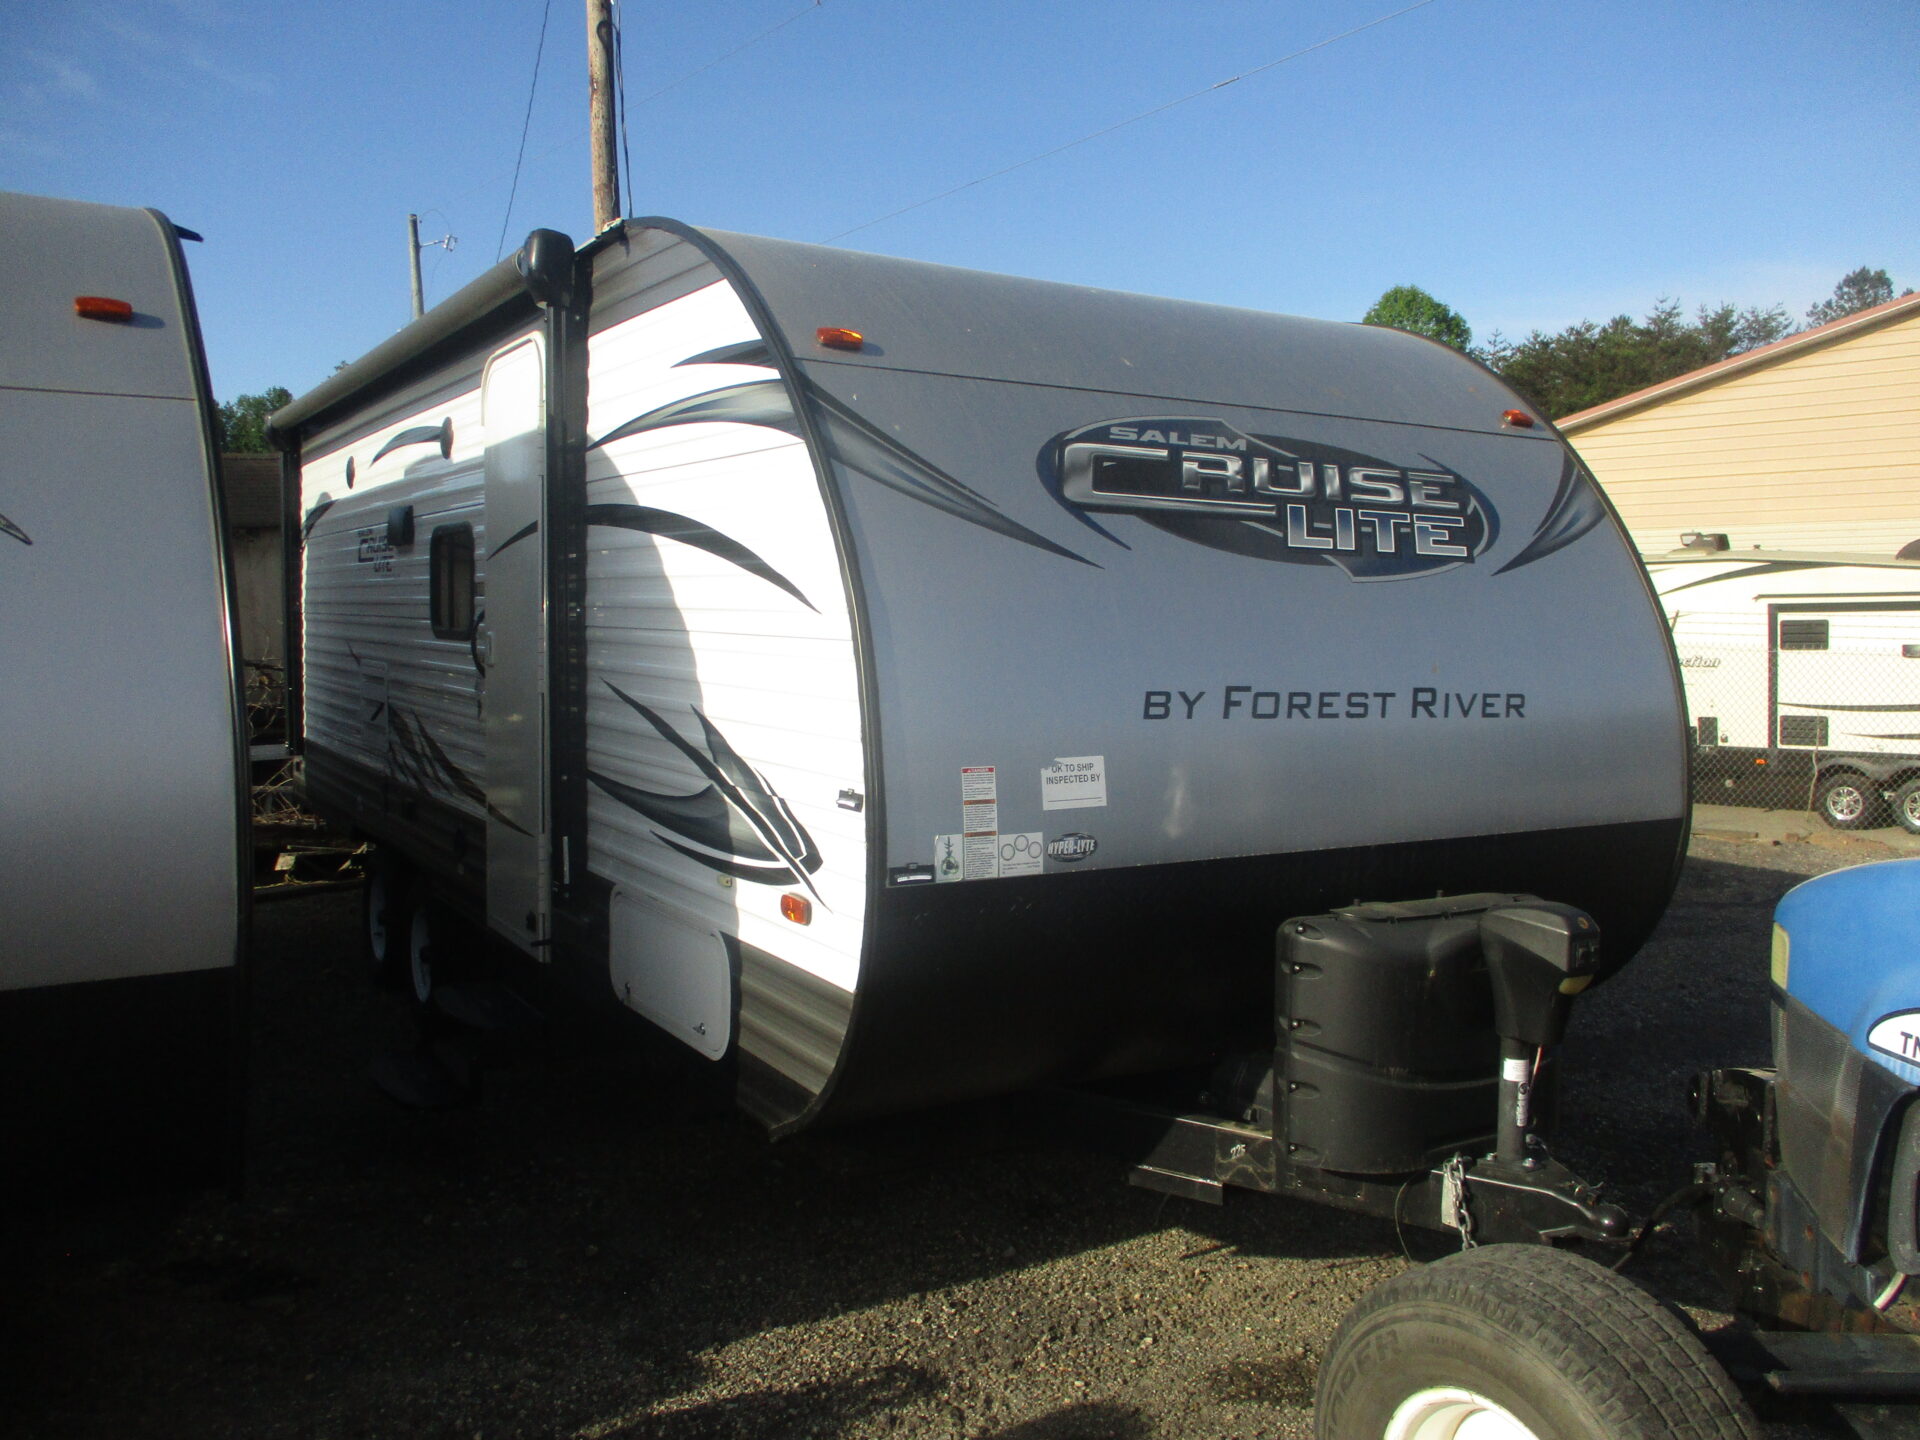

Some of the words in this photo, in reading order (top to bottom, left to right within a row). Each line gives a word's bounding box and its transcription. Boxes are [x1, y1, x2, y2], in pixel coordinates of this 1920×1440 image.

[1109, 426, 1247, 452] SALEM
[1062, 442, 1461, 517] CRUISE
[1286, 504, 1467, 557] LITE
[1142, 690, 1206, 720] BY
[1222, 685, 1397, 720] FOREST
[1410, 687, 1526, 719] RIVER
[1046, 774, 1089, 785] INSPECTED
[1090, 773, 1101, 782] BY
[1051, 765, 1063, 774] OK
[1065, 764, 1076, 773] TO
[1077, 762, 1094, 772] SHIP
[1047, 839, 1096, 855] HYPER-LYTE
